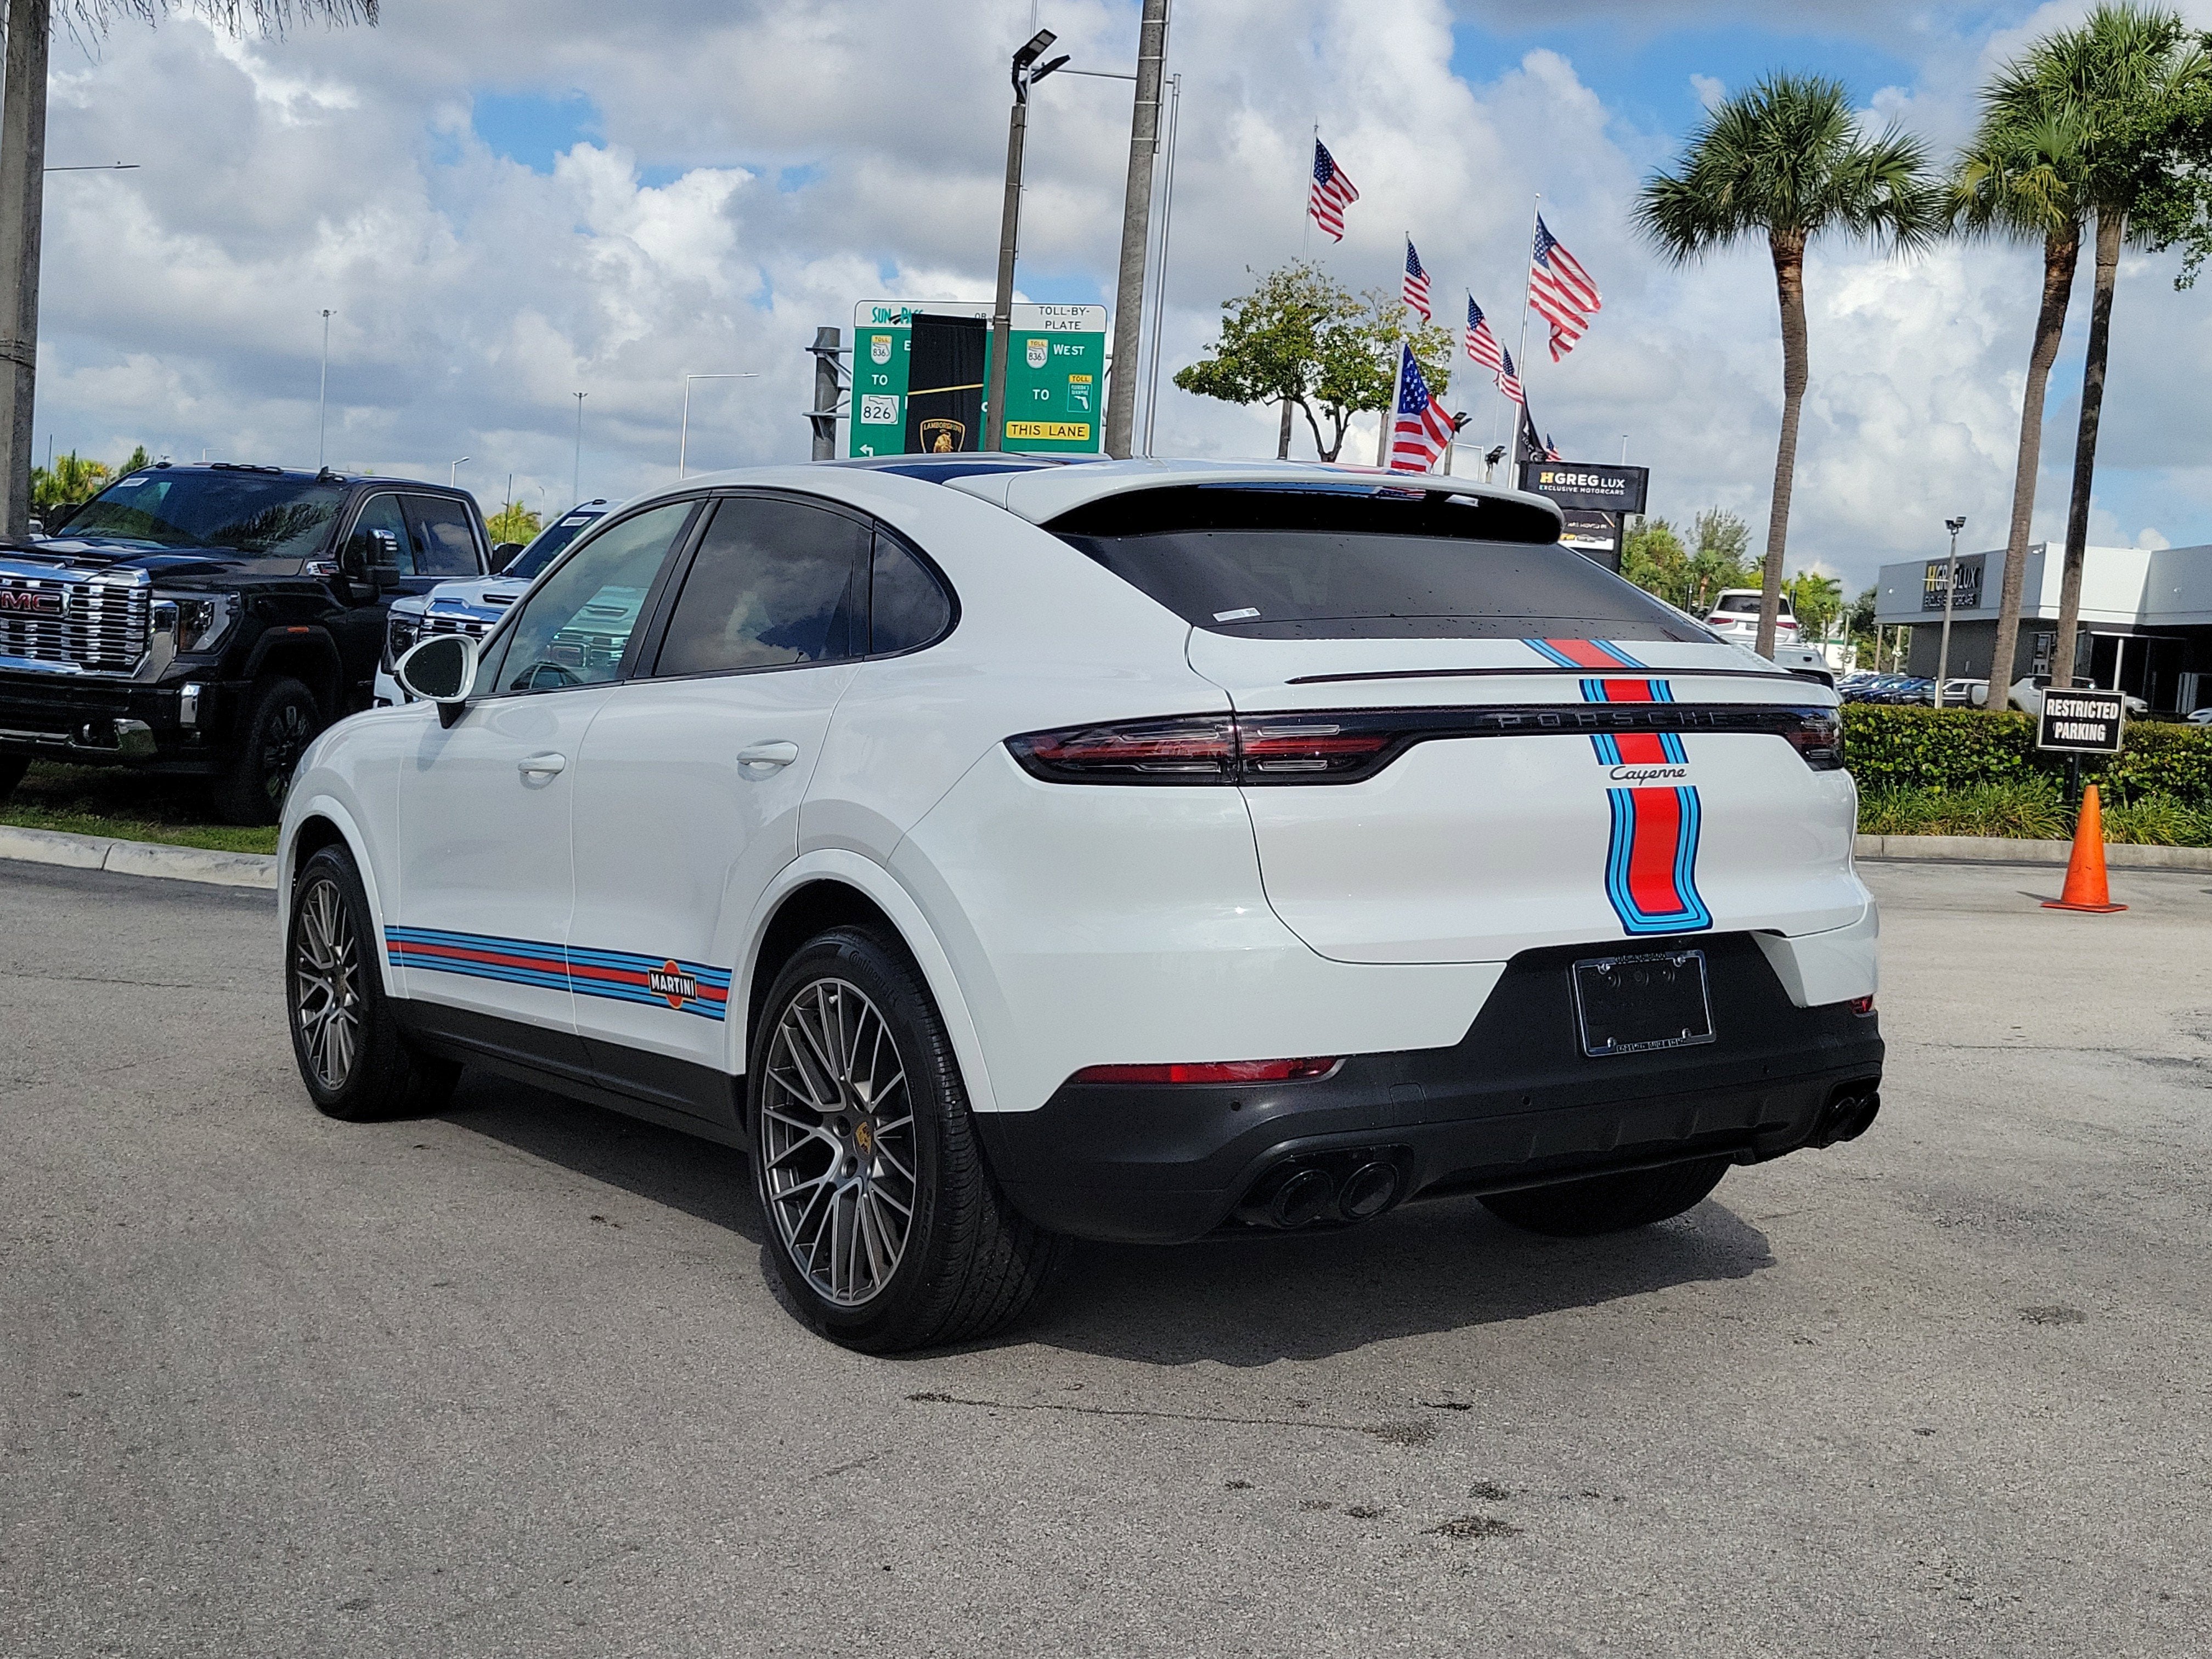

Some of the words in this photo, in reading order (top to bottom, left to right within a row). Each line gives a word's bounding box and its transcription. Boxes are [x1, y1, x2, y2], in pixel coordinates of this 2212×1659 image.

[1039, 306, 1090, 317] TOLL-BY-
[1045, 320, 1082, 330] PLATE
[873, 348, 886, 357] 836
[1028, 352, 1042, 360] 836
[1053, 343, 1085, 356] WEST
[871, 374, 888, 385] TO
[1032, 389, 1050, 400] TO
[863, 406, 891, 420] 826
[1011, 424, 1041, 436] THIS
[1049, 425, 1086, 437] LANE
[1539, 484, 1578, 493] EXCLUSIVE
[1580, 487, 1624, 495] MOTORCARS
[1600, 478, 1626, 488] LUX
[0, 591, 60, 613] MC
[2046, 698, 2119, 720] RESTRICTED
[1497, 711, 1730, 729] PORSCHE
[2054, 721, 2107, 742] PARKING
[1609, 766, 1688, 786] Cayenne
[650, 973, 695, 997] MARTINI
